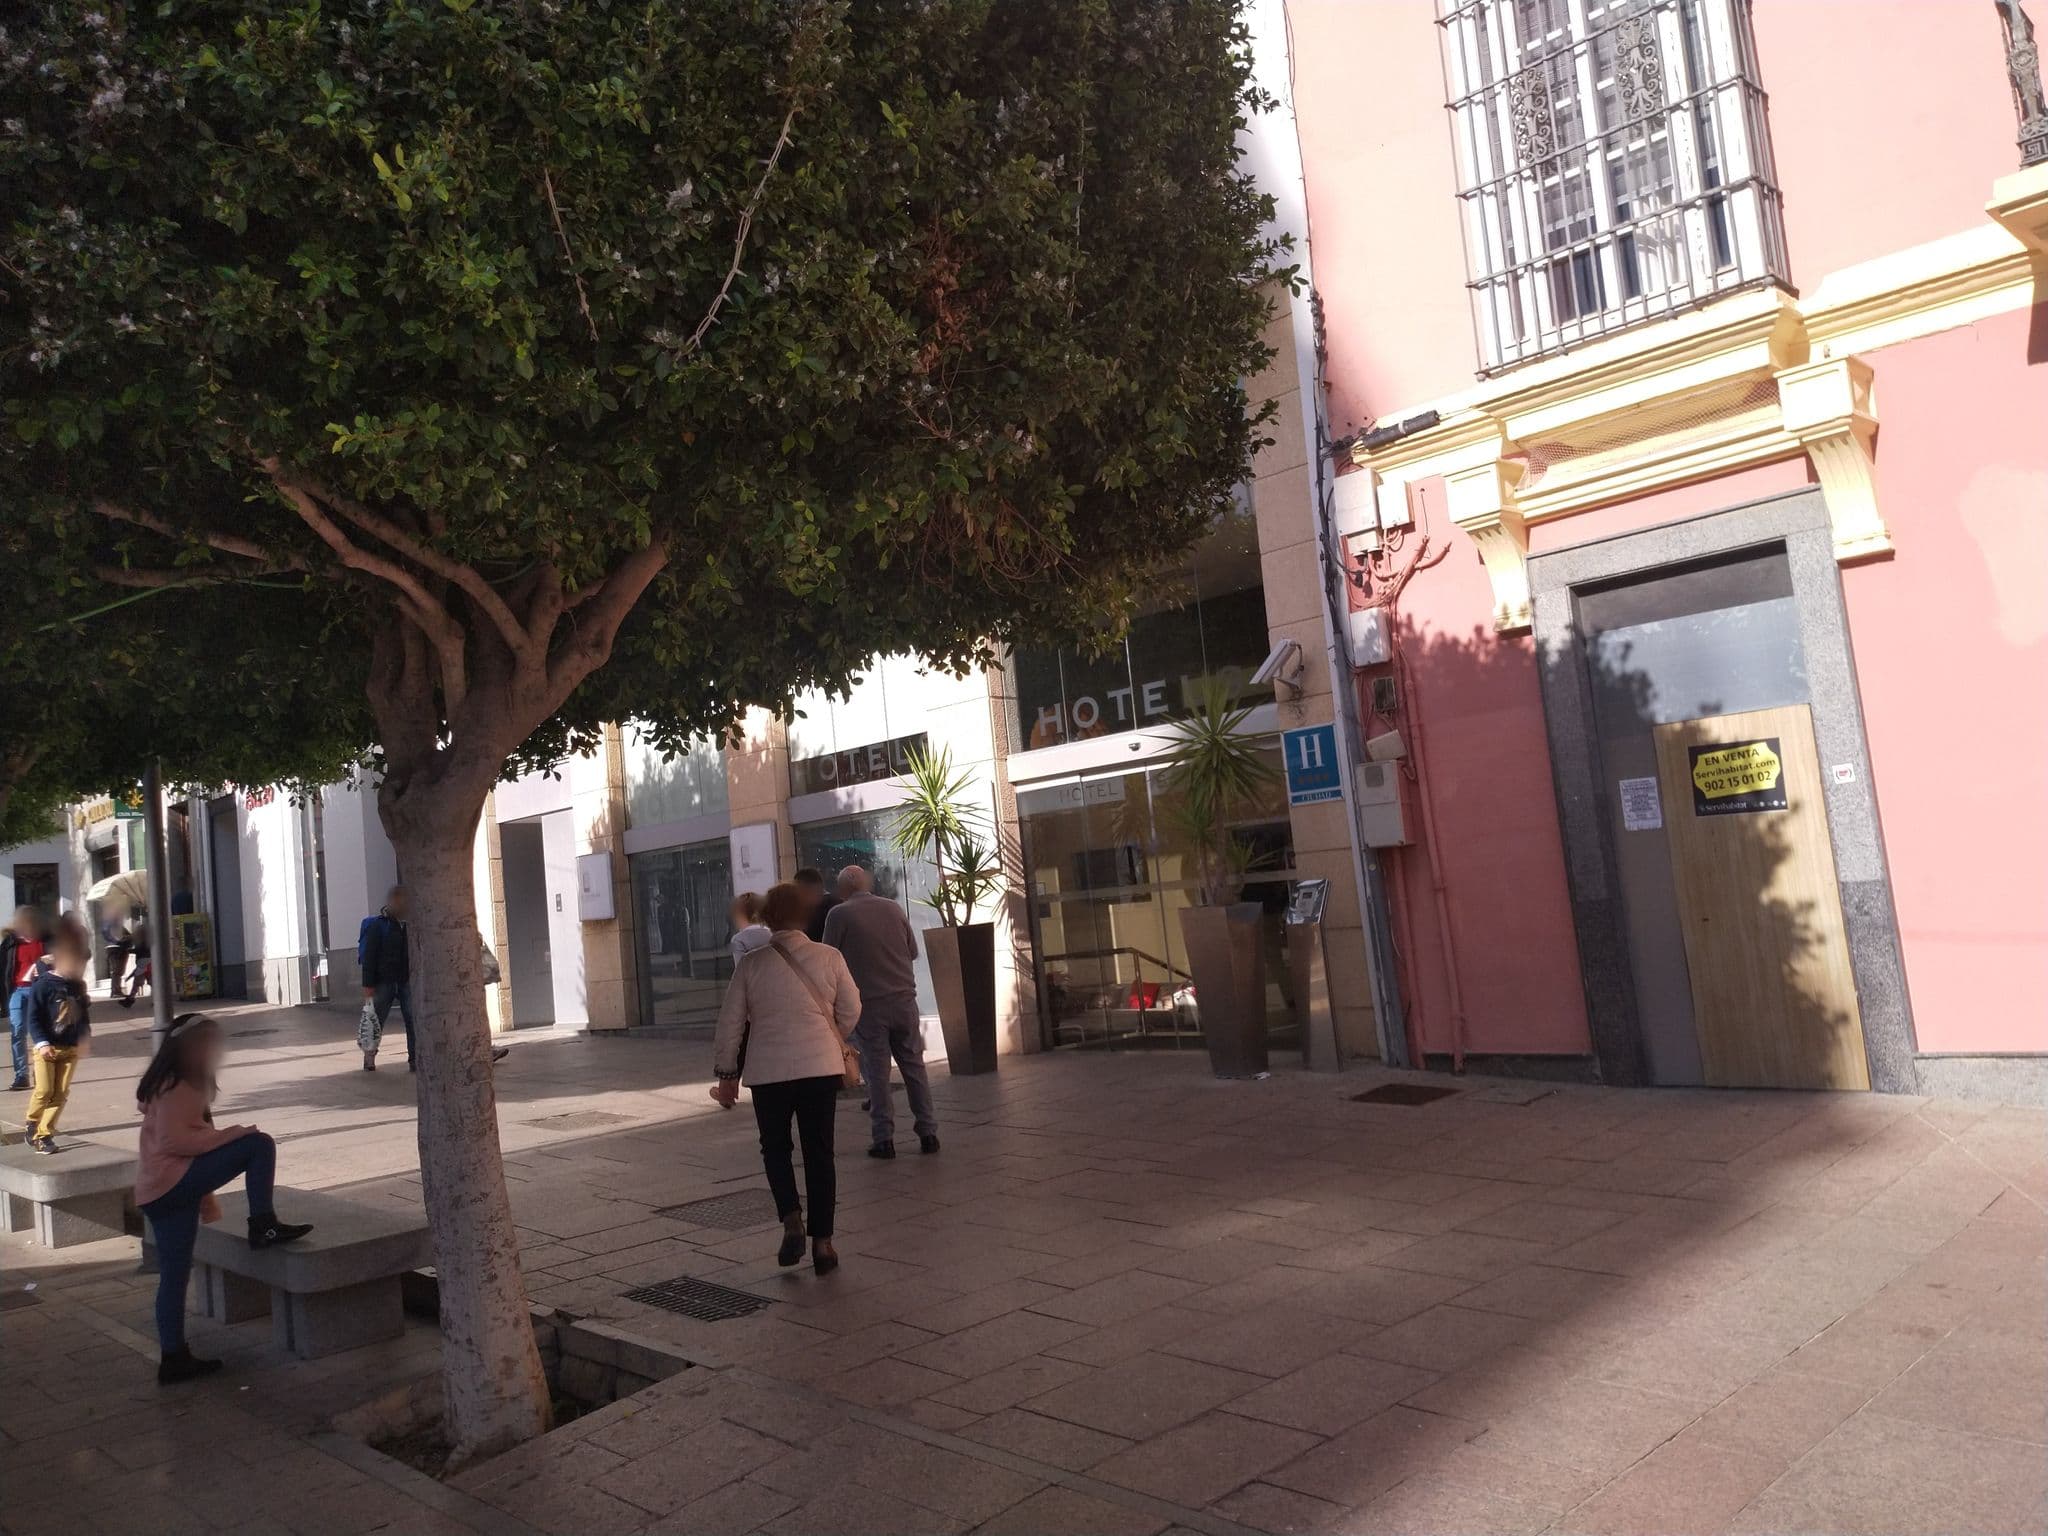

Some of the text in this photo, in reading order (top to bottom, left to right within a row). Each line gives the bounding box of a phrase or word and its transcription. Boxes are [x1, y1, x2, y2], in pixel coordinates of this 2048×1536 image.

[1296, 733, 1326, 770] H
[1704, 748, 1760, 767] EN VENTA
[1704, 770, 1772, 792] 902 15 01 02
